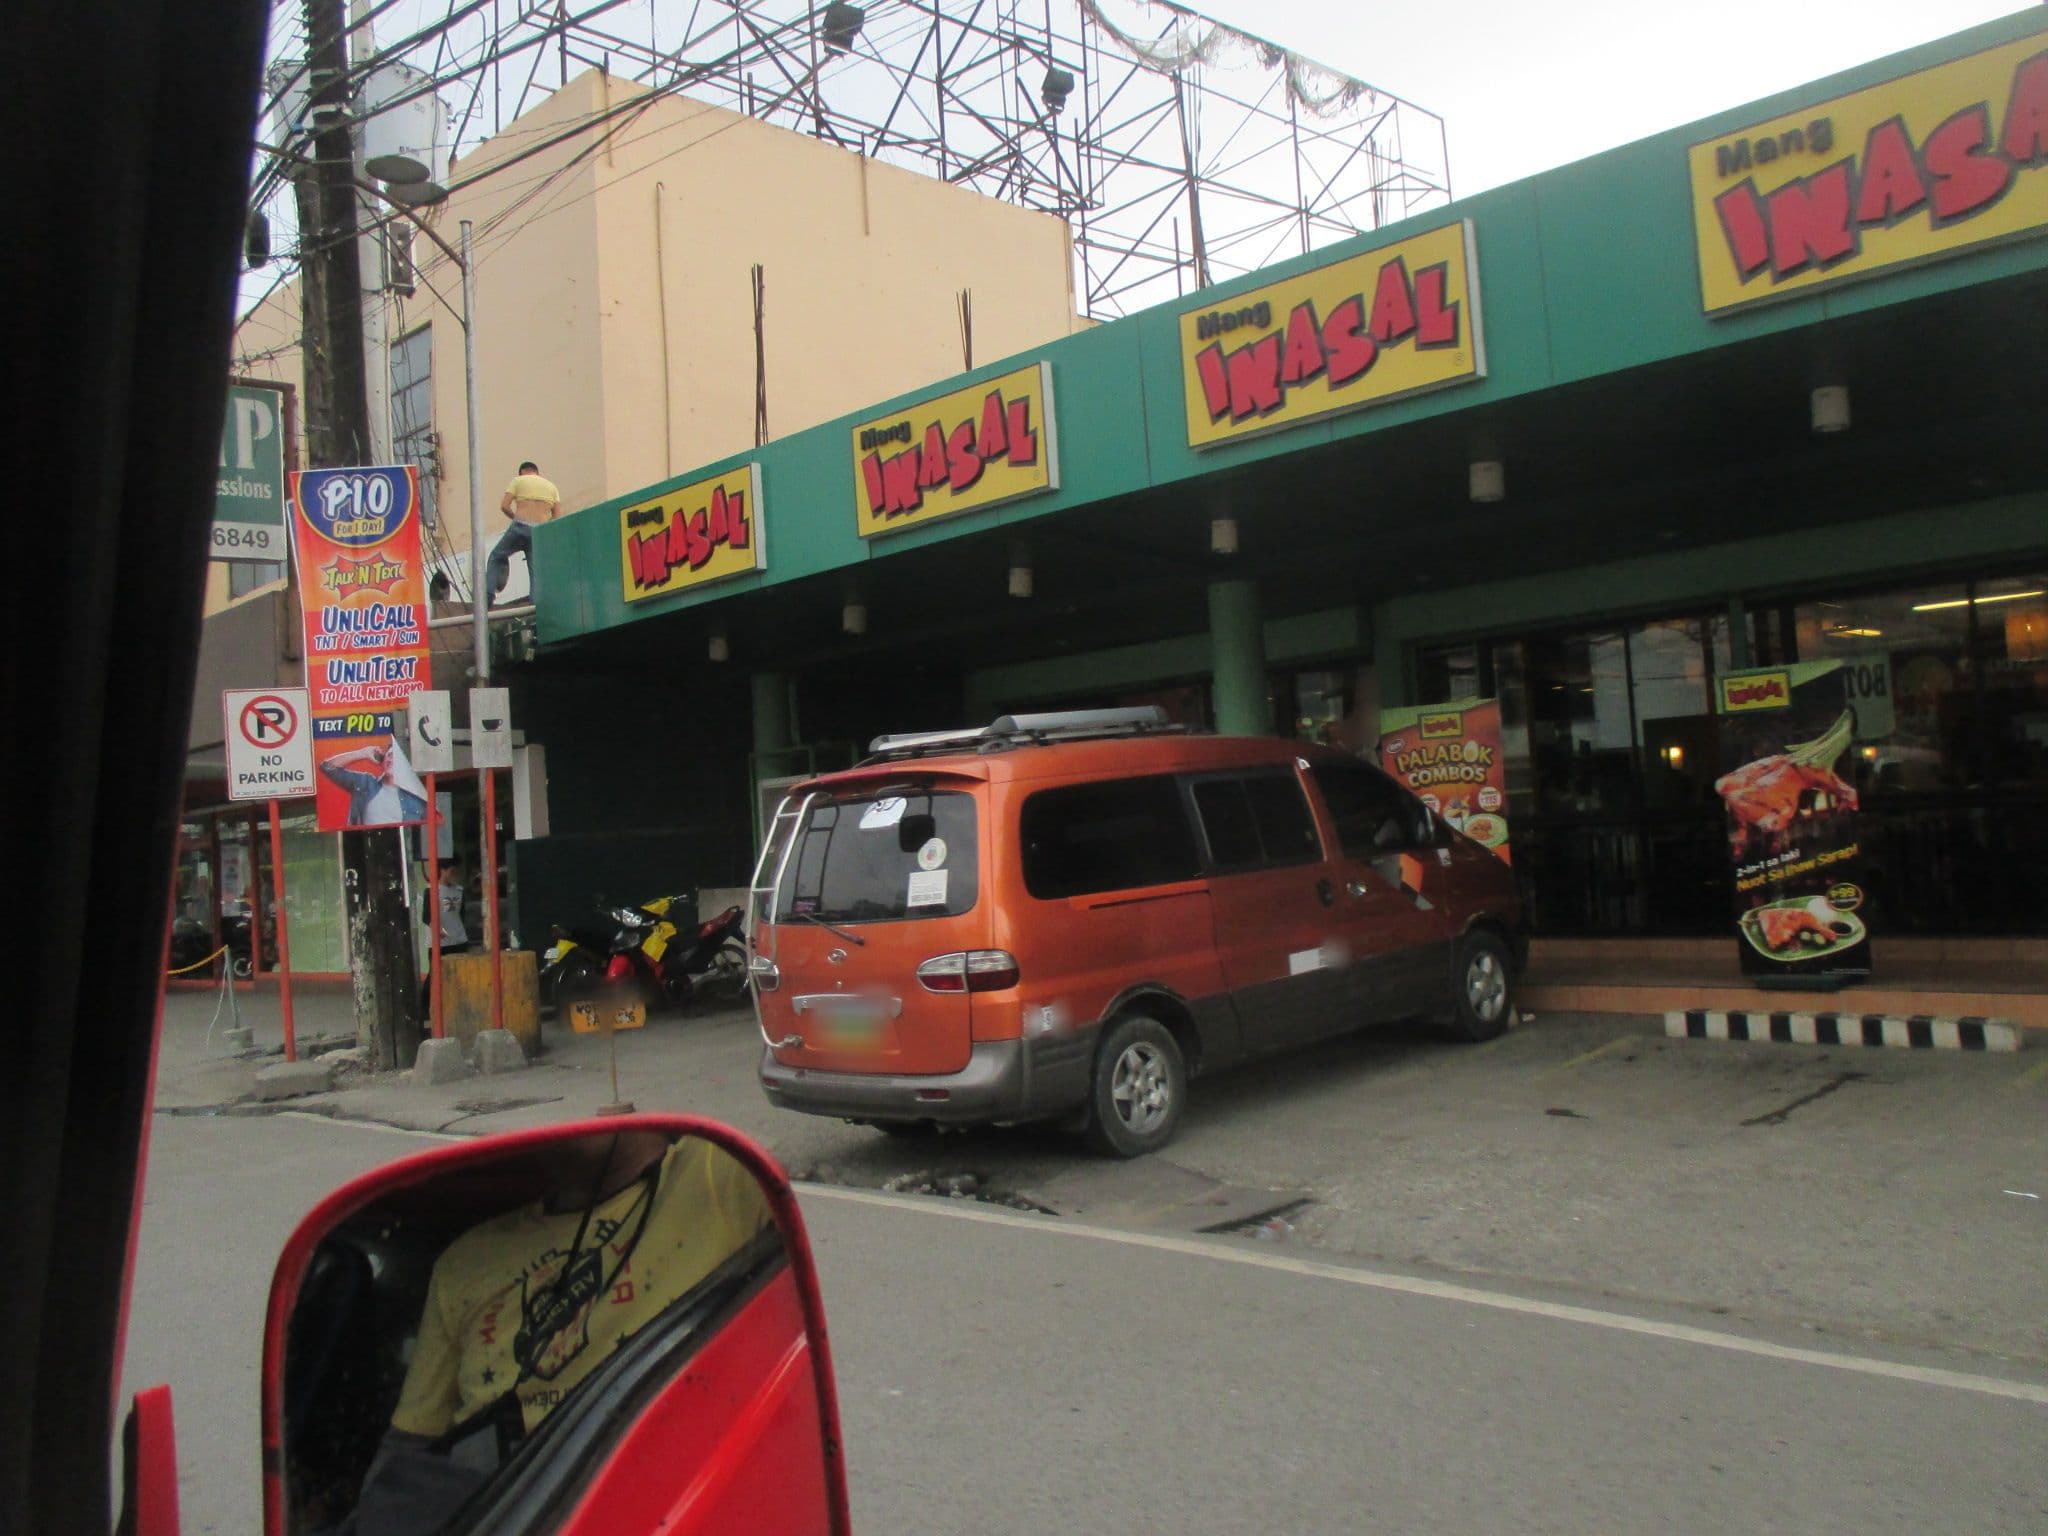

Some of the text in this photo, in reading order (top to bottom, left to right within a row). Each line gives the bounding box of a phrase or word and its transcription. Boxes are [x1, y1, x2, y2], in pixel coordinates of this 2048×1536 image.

[1715, 117, 1833, 178] Mang
[1196, 301, 1271, 341] Mang
[1195, 254, 1459, 427] INASAL
[862, 388, 1037, 521] INASAL
[212, 527, 270, 549] 6849
[627, 484, 750, 592] INASAL
[327, 567, 354, 590] TALK
[373, 562, 400, 584] TEXT
[314, 635, 338, 650] TNT
[353, 633, 388, 648] SMART
[400, 631, 419, 645] SUN
[320, 689, 337, 704] TO
[340, 685, 364, 703] ALL
[319, 720, 344, 733] TEXT
[378, 717, 391, 728] TO
[260, 754, 282, 767] NO
[239, 770, 305, 785] PARKING
[1408, 764, 1486, 787] COMBOS
